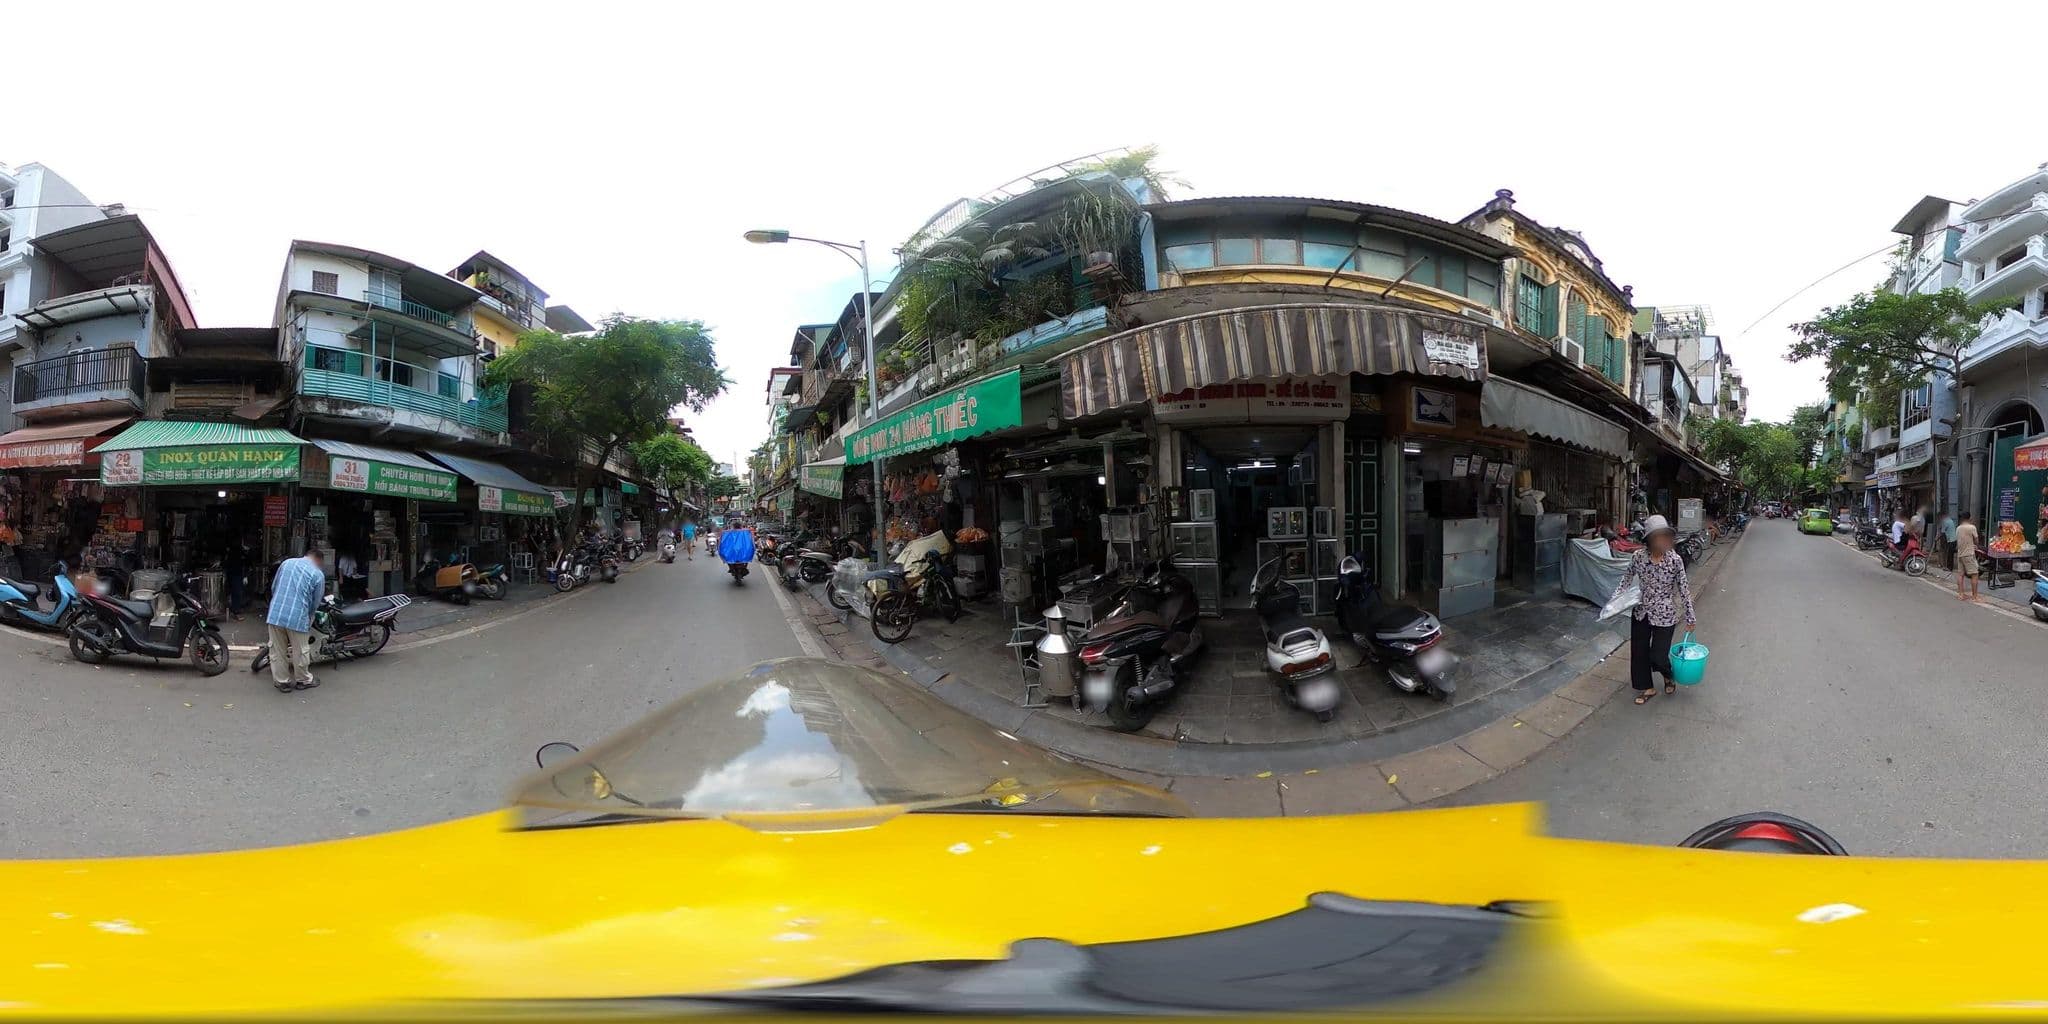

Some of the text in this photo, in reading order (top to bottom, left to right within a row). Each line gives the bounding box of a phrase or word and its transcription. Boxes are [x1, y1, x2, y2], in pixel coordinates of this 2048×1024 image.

[115, 452, 130, 467] 29
[160, 449, 284, 465] INOX QUÂN HẠNH
[344, 461, 357, 474] 31
